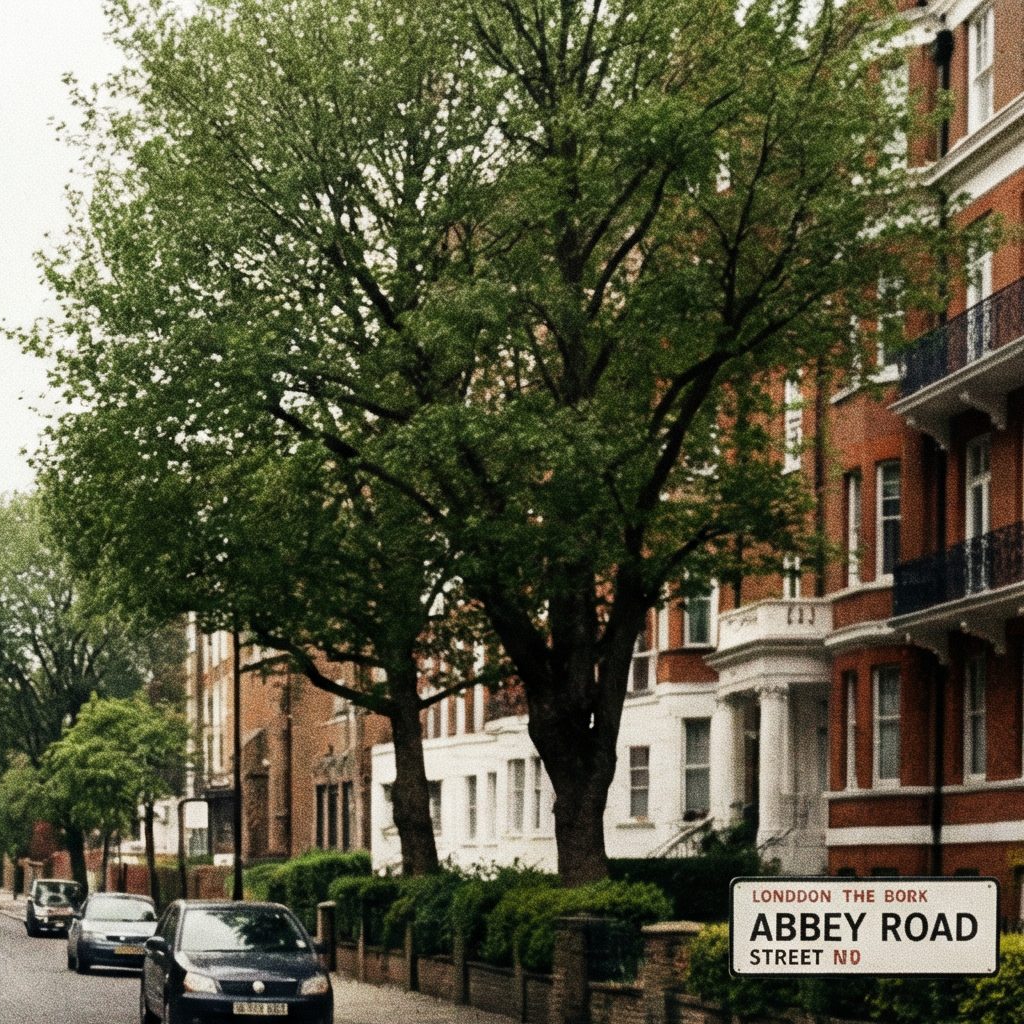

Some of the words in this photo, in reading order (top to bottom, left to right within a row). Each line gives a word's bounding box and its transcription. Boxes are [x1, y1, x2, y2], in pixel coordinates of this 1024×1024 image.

[753, 889, 832, 903] LONDDON
[842, 889, 876, 903] THE
[884, 889, 929, 903] BORK
[749, 912, 867, 942] ABBEY
[881, 912, 979, 942] ROAD
[749, 949, 824, 966] STREET
